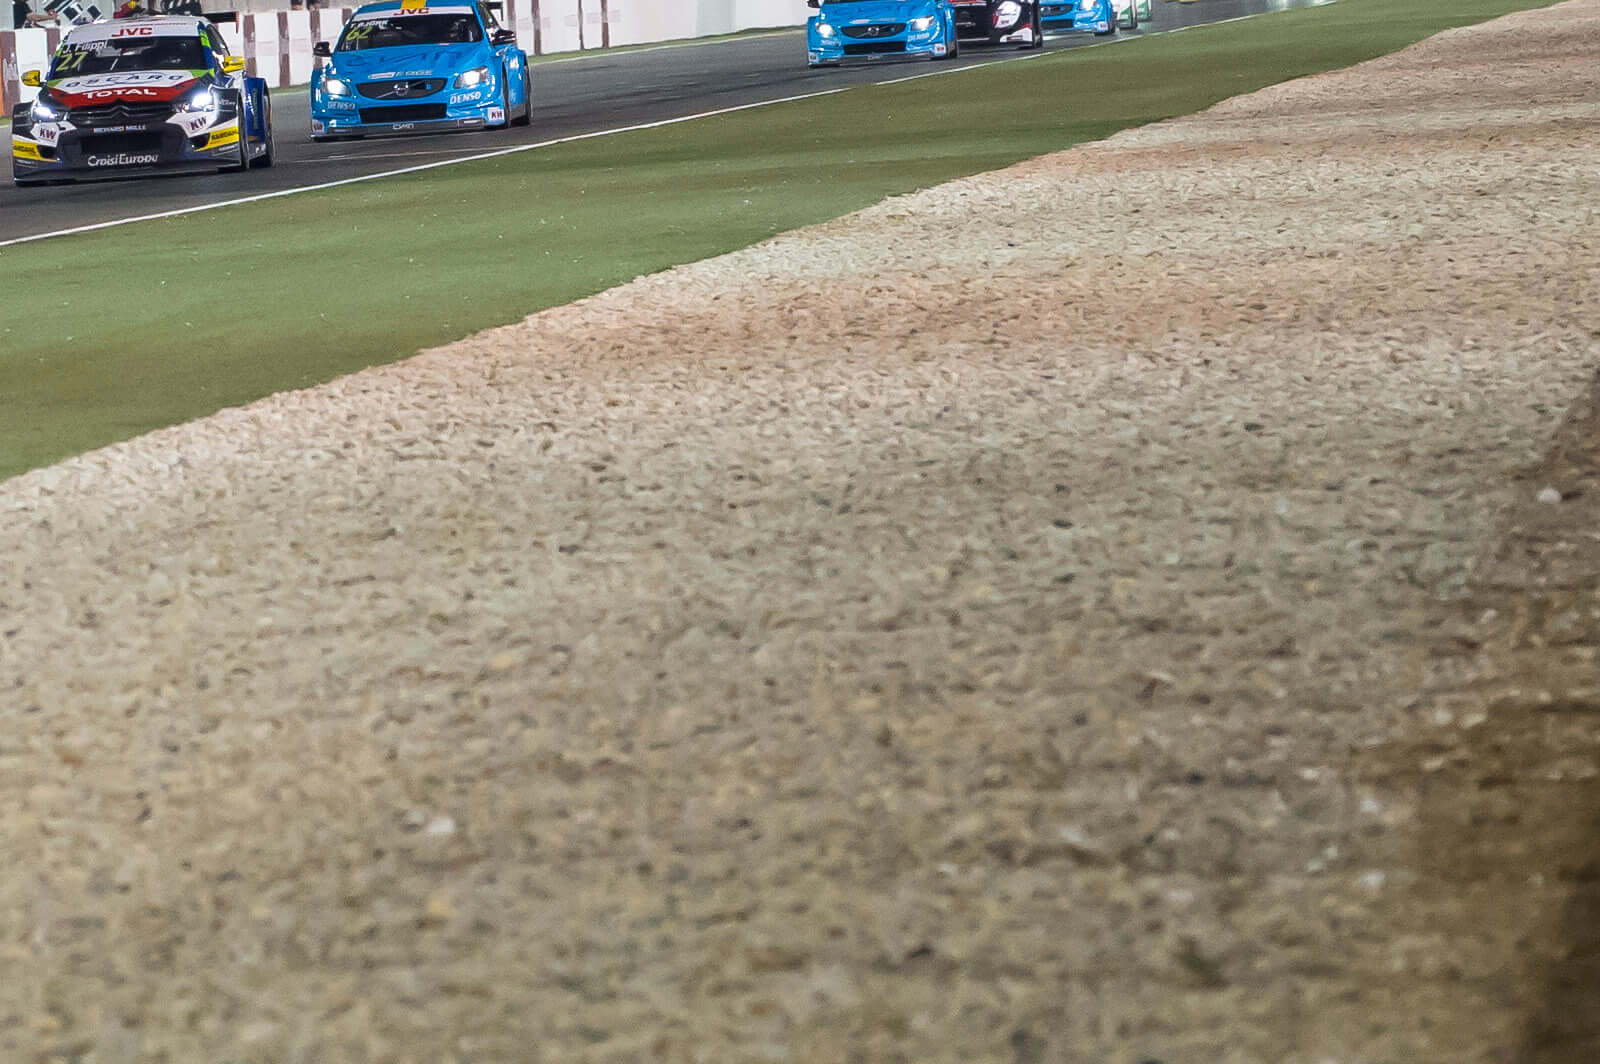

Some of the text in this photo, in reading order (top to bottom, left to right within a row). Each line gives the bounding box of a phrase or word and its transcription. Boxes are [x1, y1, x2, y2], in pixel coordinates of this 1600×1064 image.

[394, 8, 430, 16] JVC
[111, 27, 153, 37] JVC
[55, 51, 89, 72] 27
[82, 87, 158, 100] TOTAL
[450, 91, 481, 105] DENSO
[189, 116, 208, 131] KW
[39, 127, 57, 140] KW
